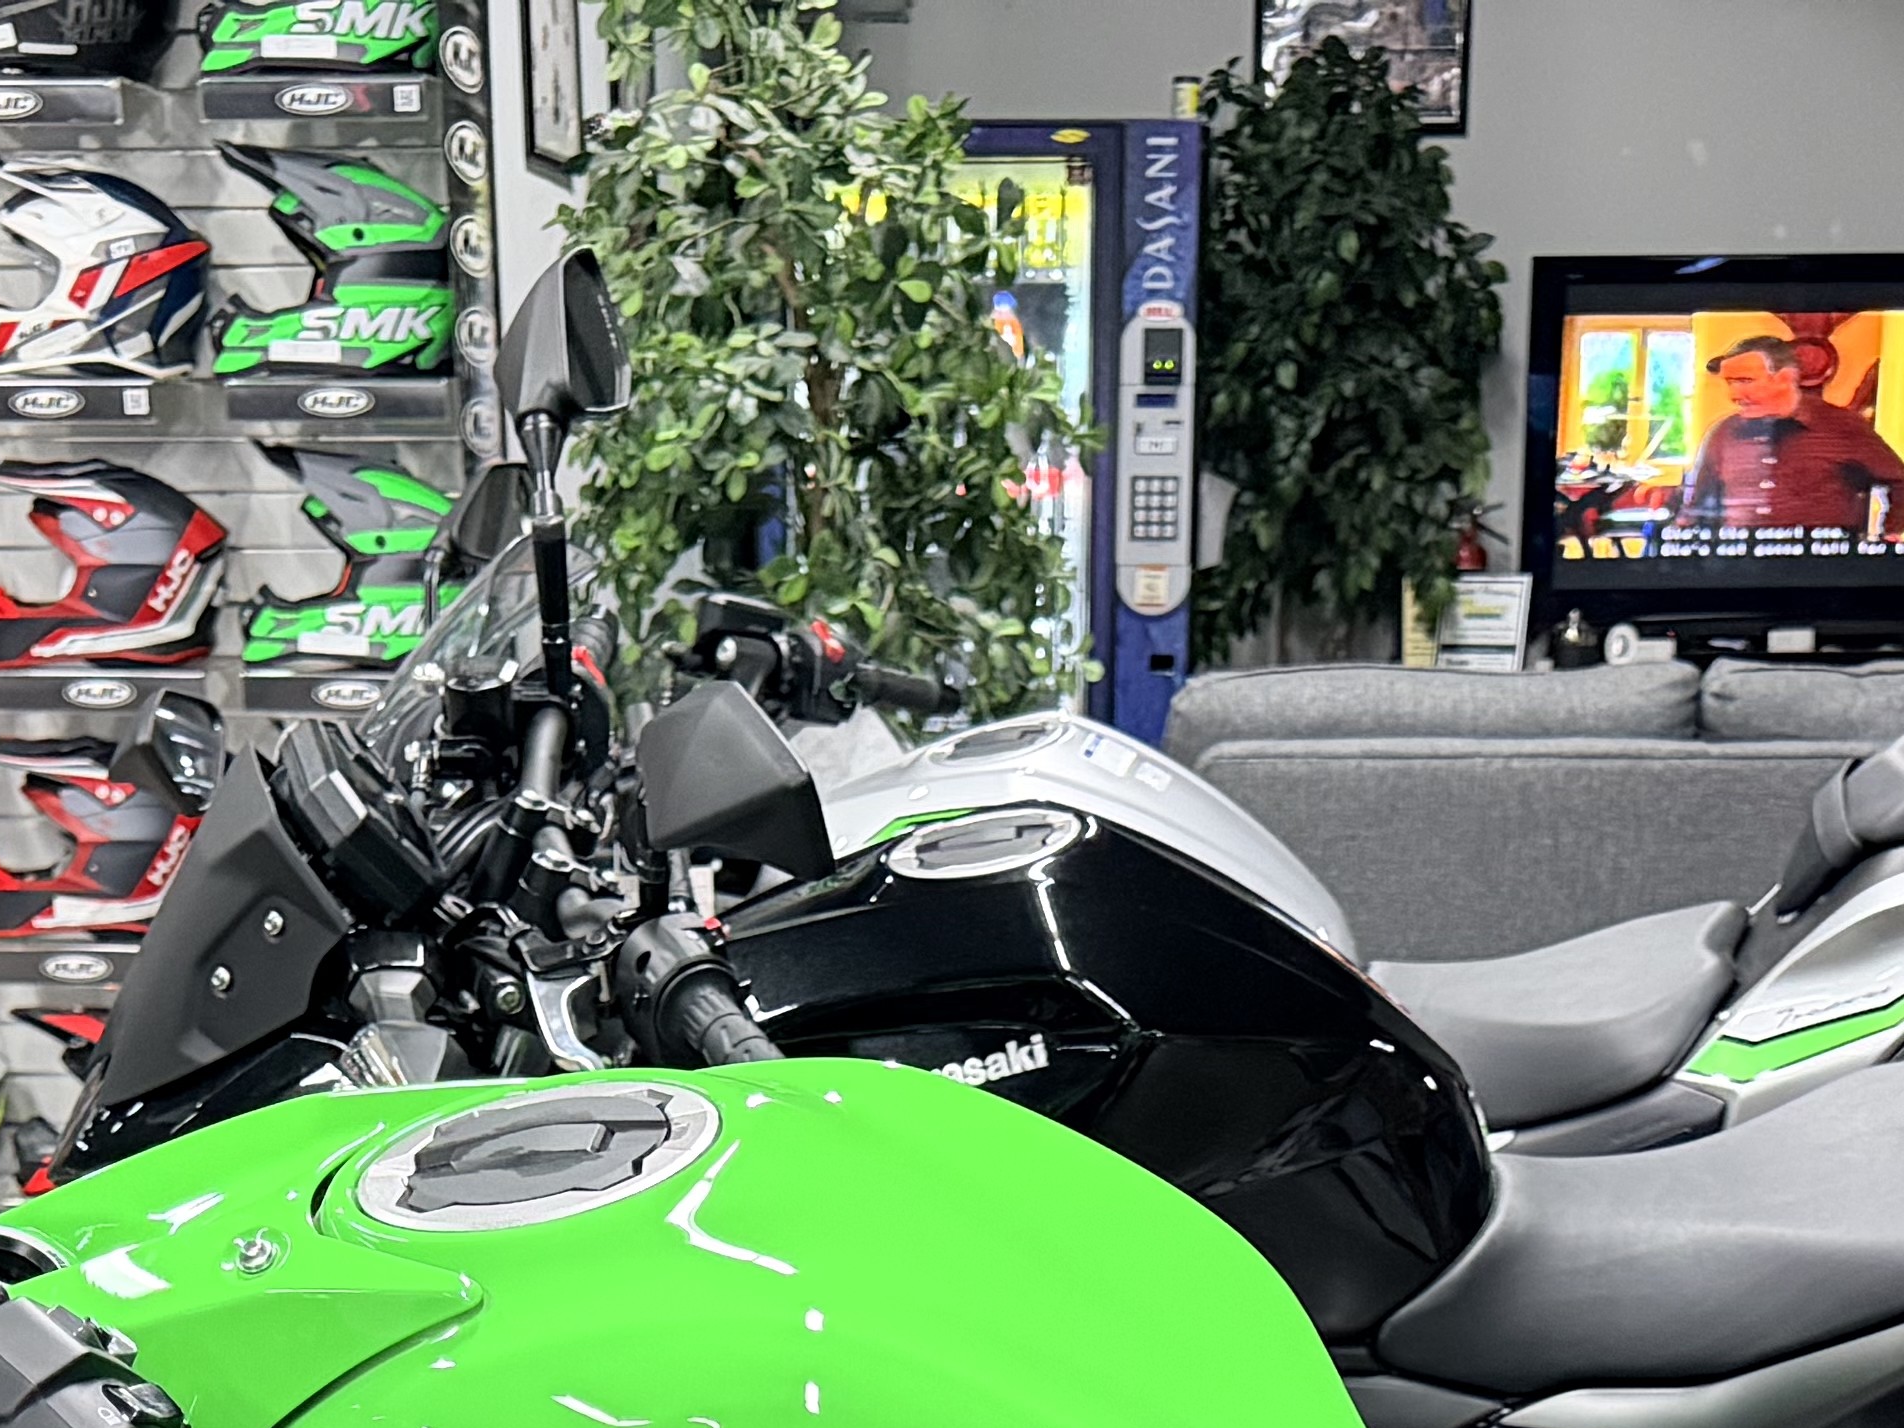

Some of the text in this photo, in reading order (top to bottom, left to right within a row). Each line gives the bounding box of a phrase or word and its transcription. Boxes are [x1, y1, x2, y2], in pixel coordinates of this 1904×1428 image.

[290, 0, 432, 40] SMK
[1136, 136, 1182, 290] DASANI
[296, 303, 449, 342] SMK
[147, 549, 195, 612] HJC
[930, 1032, 1050, 1087] asaki
